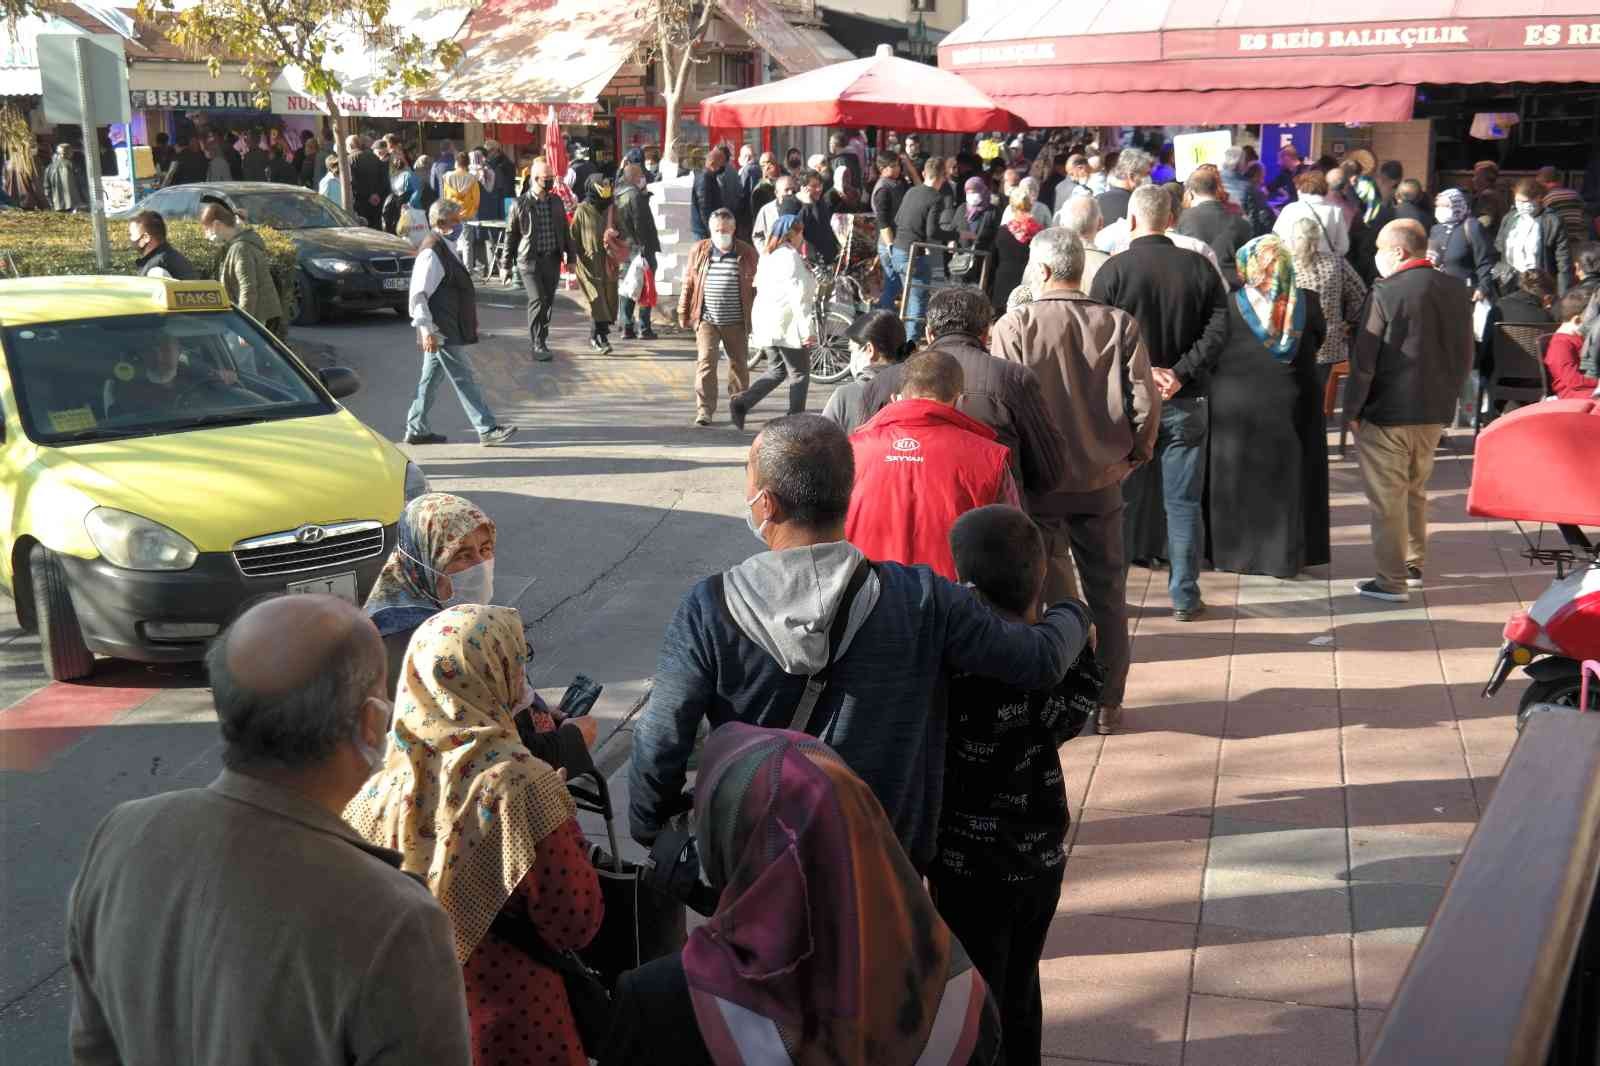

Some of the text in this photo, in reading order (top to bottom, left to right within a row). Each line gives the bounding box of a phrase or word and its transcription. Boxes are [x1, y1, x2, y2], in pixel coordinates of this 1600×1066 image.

[1238, 34, 1267, 50] ES
[1328, 26, 1469, 48] BALIKÇILIK
[1523, 24, 1561, 46] ES
[145, 91, 211, 106] BESLER
